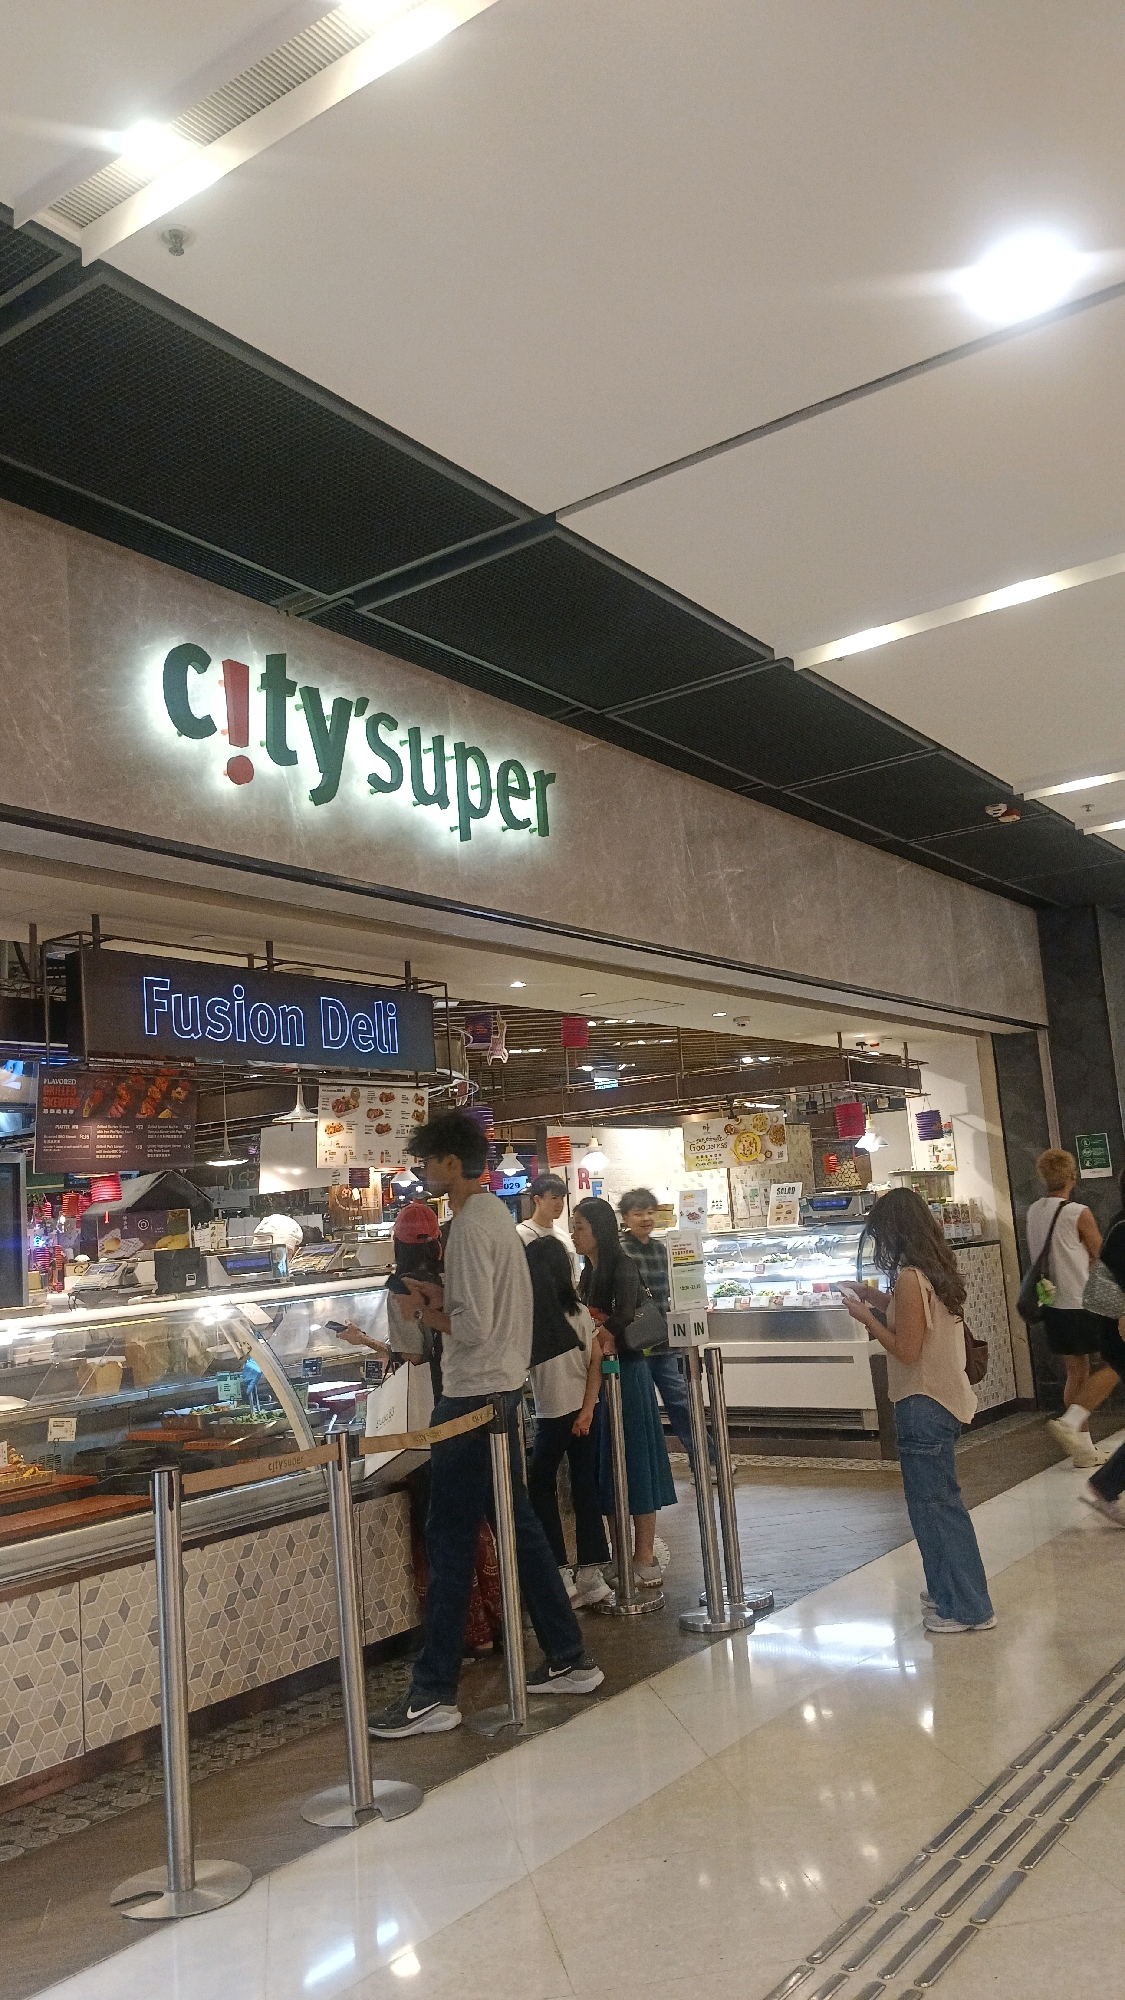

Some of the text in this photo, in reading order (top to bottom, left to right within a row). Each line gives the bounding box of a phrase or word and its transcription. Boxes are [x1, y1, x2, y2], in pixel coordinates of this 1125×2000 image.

[142, 975, 399, 1055] Fusion Deli
[43, 1085, 77, 1096] GRILLED
[577, 1167, 591, 1190] R
[672, 1323, 687, 1337] IN
[693, 1321, 705, 1336] IN
